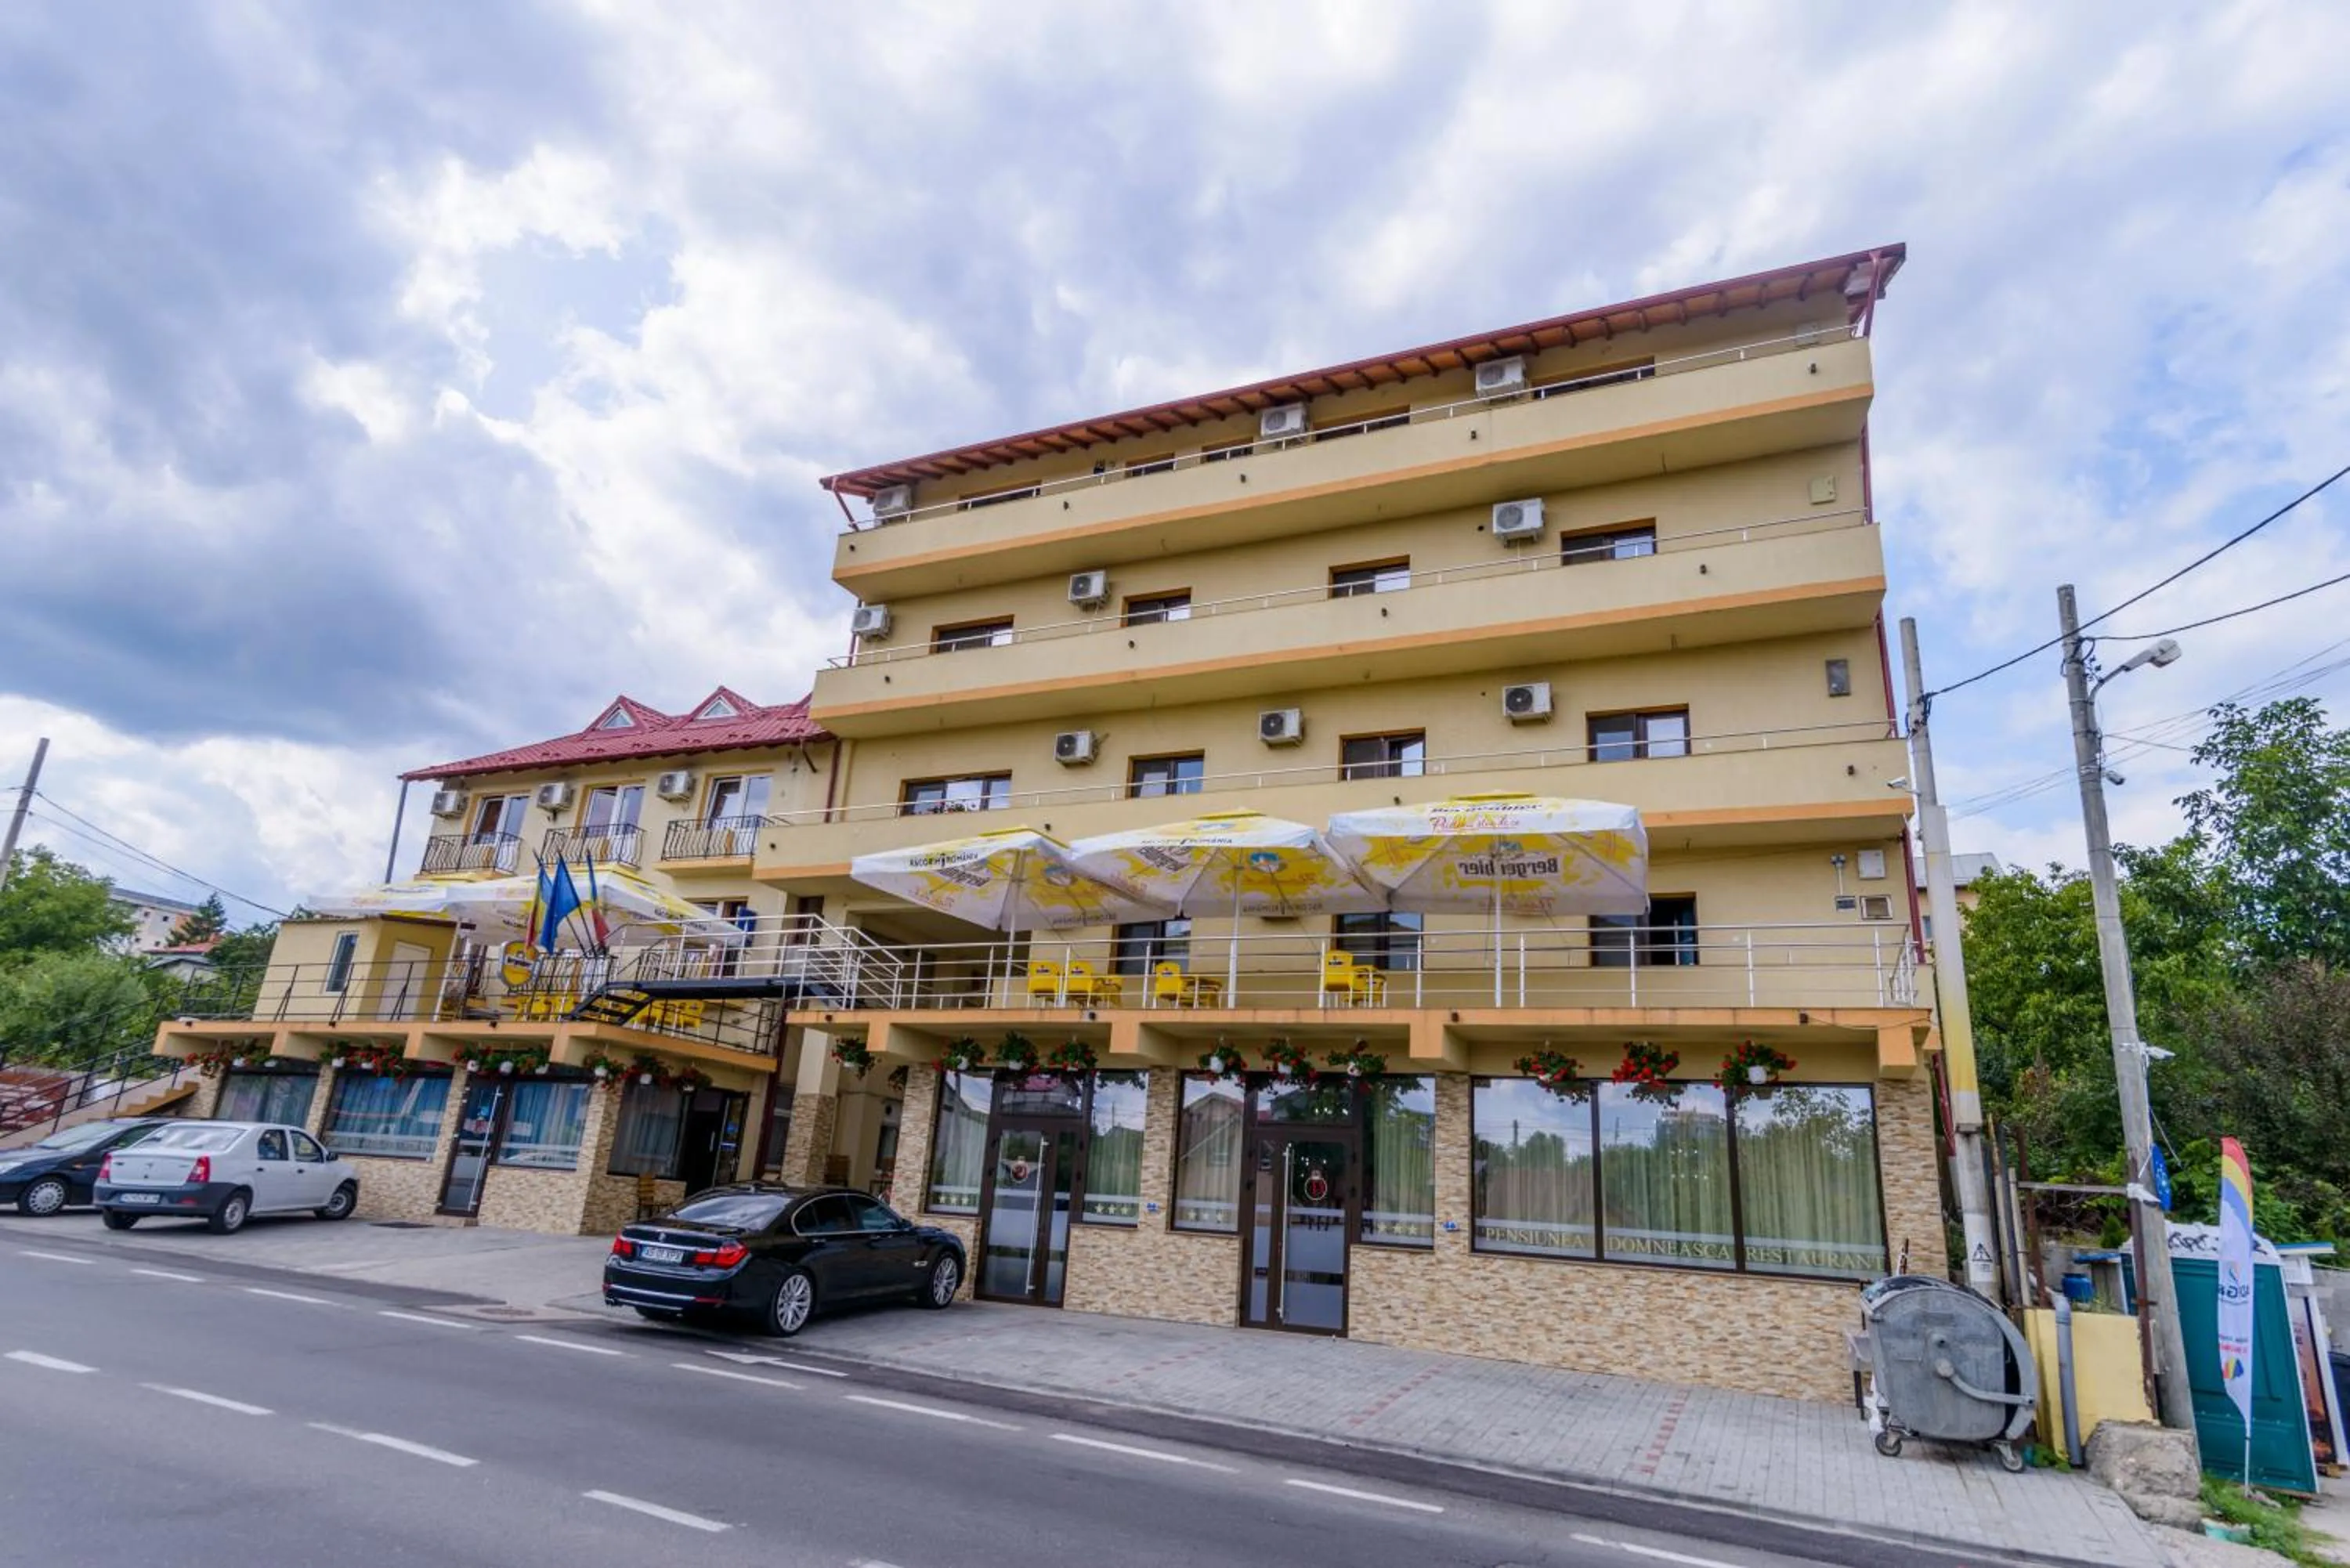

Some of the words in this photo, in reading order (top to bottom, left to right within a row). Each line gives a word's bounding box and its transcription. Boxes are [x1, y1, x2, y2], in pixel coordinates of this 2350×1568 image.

[1485, 1227, 1585, 1248] PENSIUNEA
[1607, 1235, 1731, 1261] DOMNEASCA
[1744, 1245, 1886, 1273] RESTAURANT
